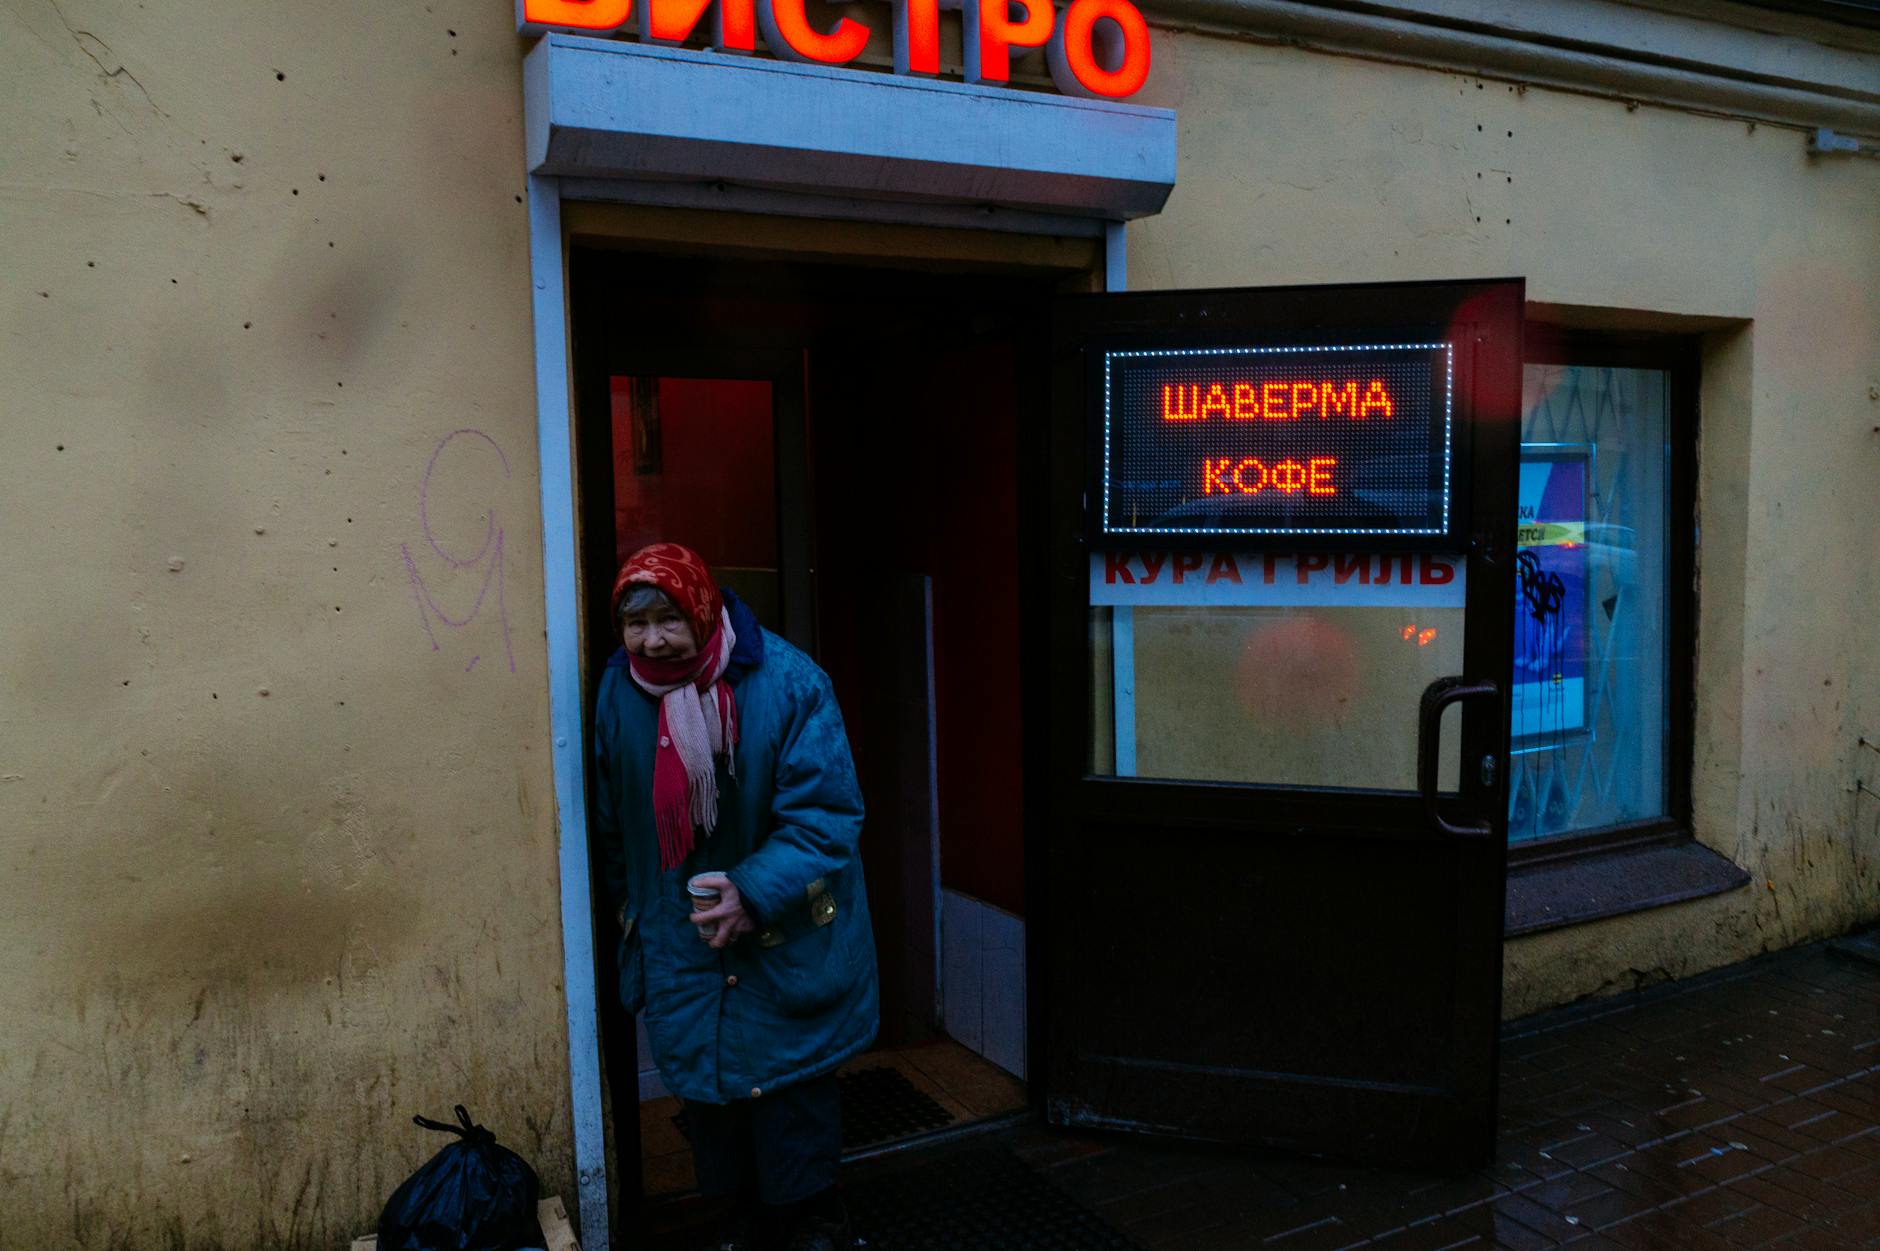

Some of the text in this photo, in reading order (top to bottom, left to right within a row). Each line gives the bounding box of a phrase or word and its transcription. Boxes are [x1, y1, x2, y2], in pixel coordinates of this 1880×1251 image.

[520, 0, 1152, 98] СТРО
[1162, 380, 1394, 422] ШАВЕРМА
[1203, 457, 1338, 496] КОФЕ
[1104, 552, 1455, 586] КУРА ГРИЛЬ
